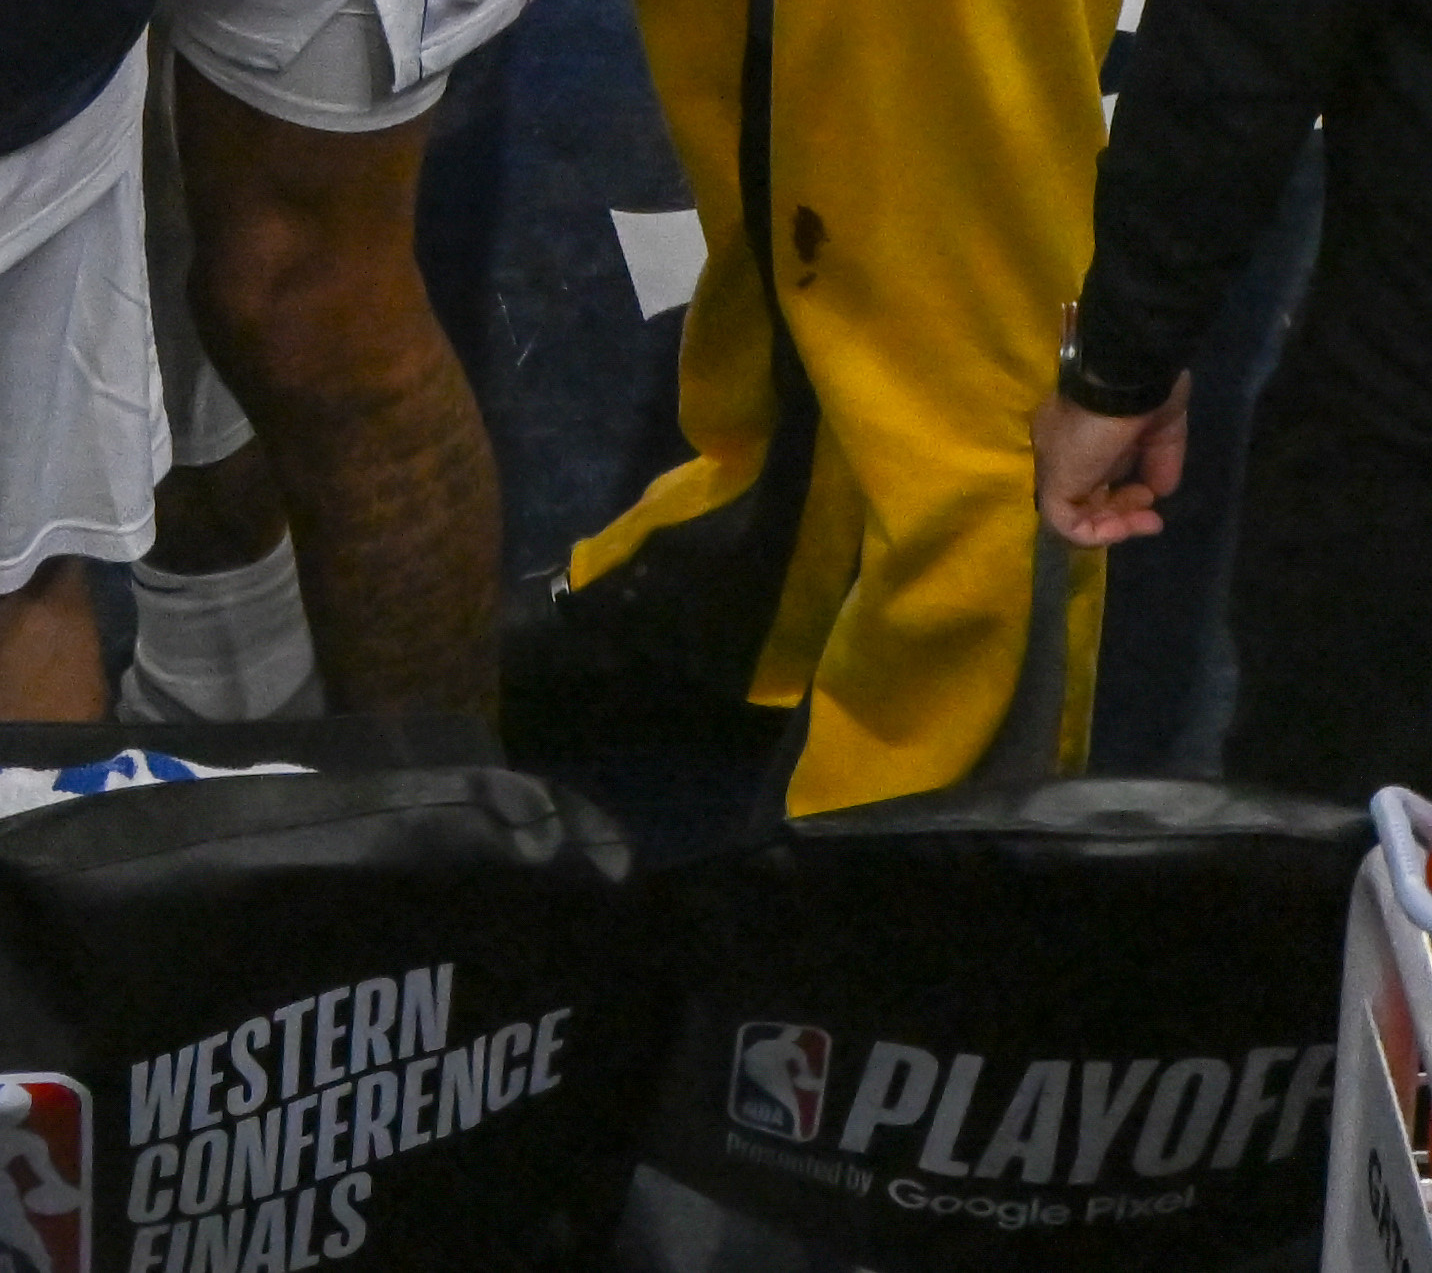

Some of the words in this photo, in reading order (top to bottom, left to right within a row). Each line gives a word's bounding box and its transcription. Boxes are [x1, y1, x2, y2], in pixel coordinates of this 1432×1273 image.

[126, 1007, 572, 1225] CONFERENCE
[128, 962, 455, 1148] WESTERN
[129, 1170, 373, 1273] FINALS
[887, 1177, 1072, 1231] Google
[1084, 1184, 1196, 1227] Pixel
